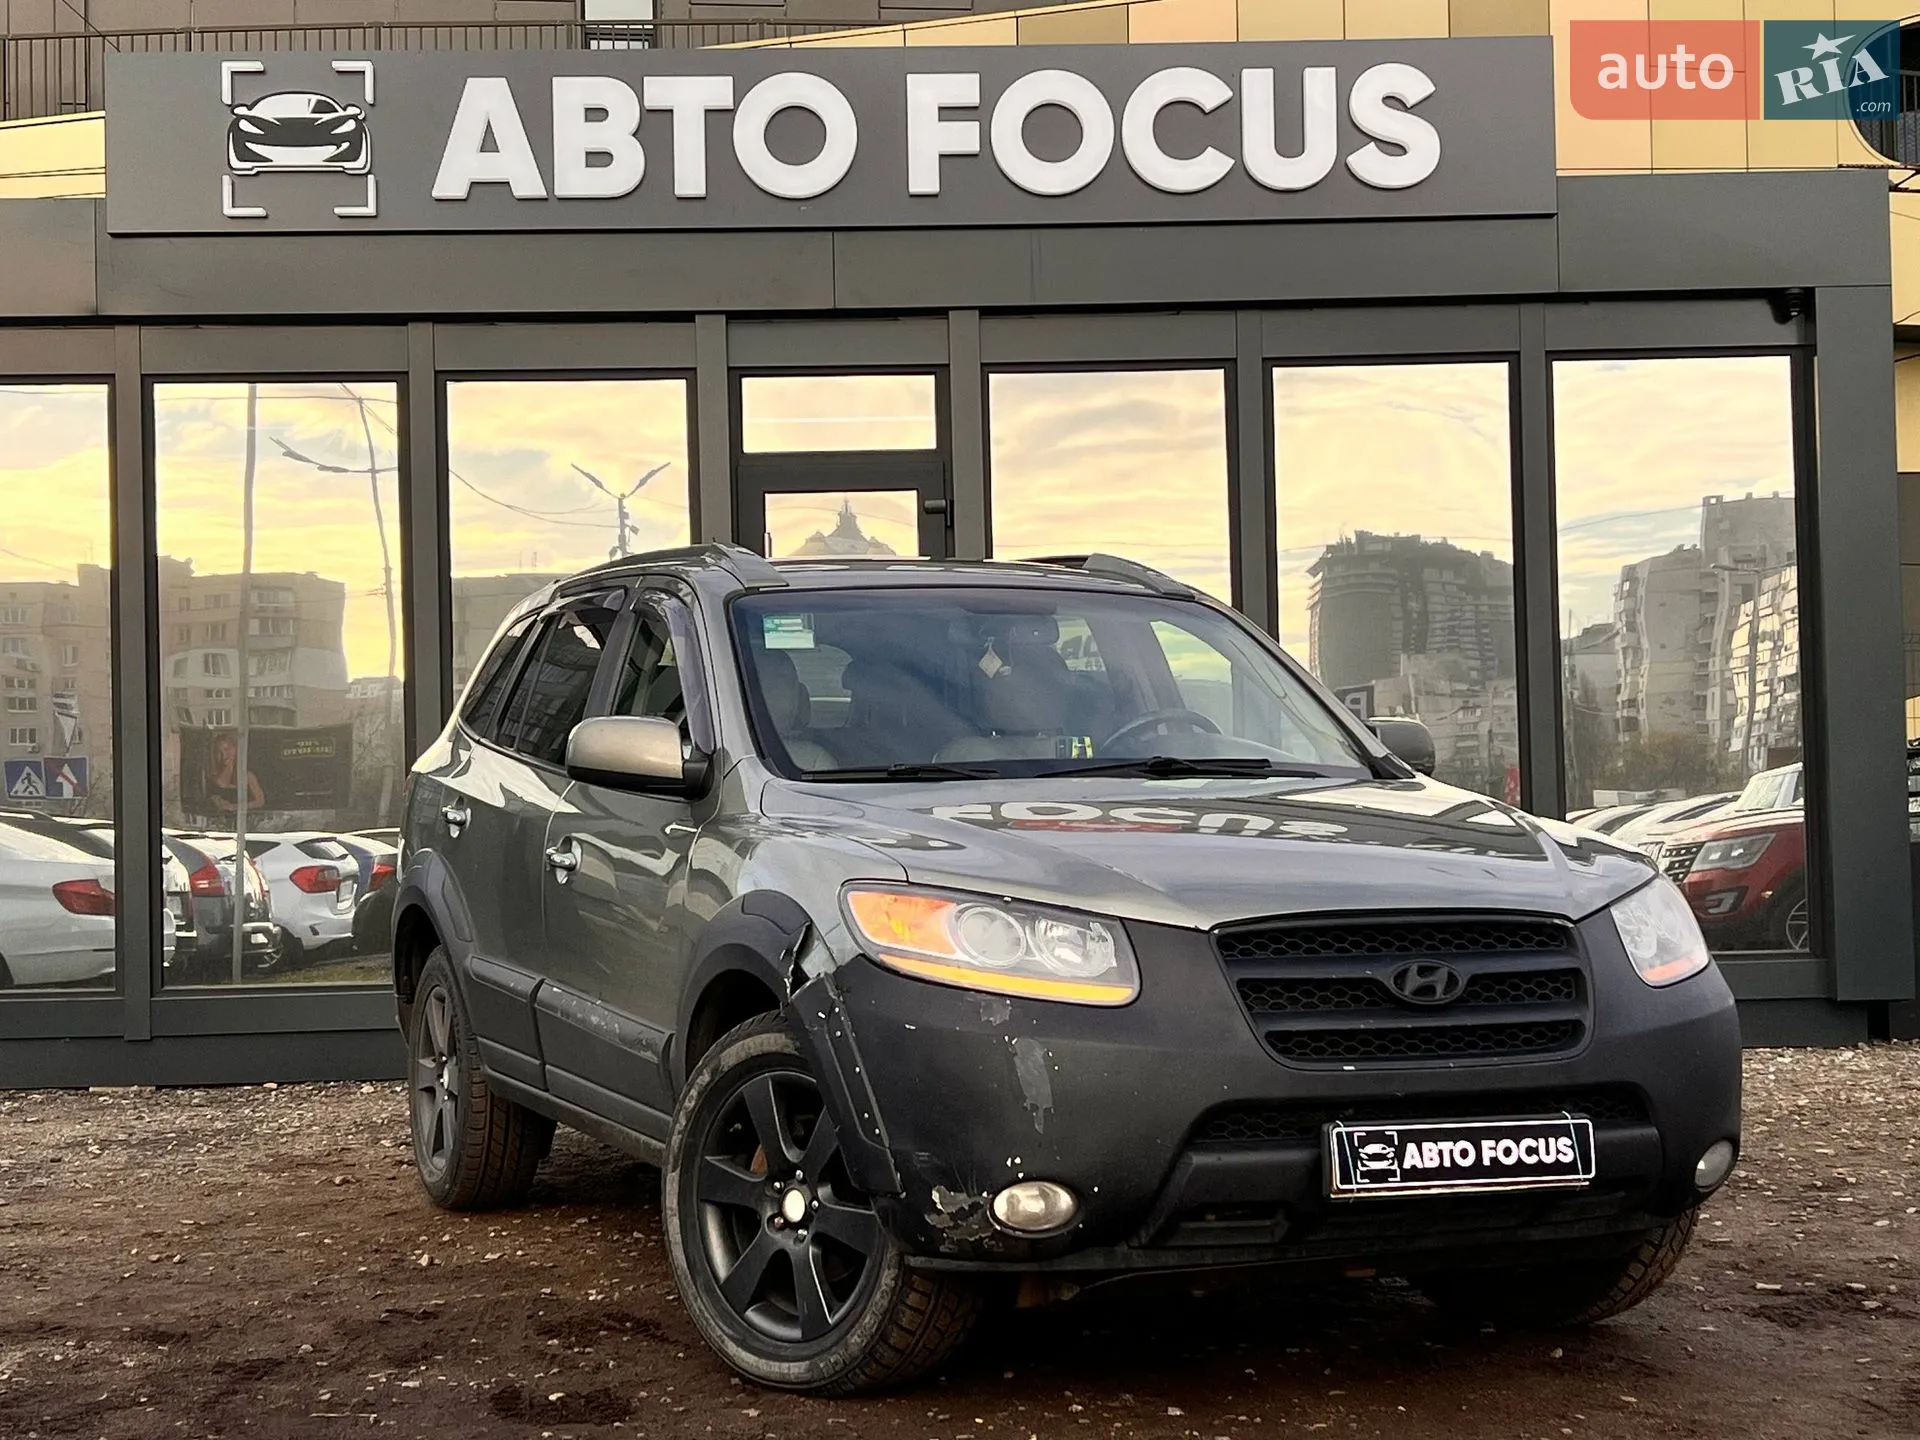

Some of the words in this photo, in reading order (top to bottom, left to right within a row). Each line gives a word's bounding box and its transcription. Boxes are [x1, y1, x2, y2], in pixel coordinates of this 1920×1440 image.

[431, 71, 859, 200] АВТО
[905, 61, 1442, 197] FOCUS
[1402, 1138, 1476, 1170] АВТО
[1481, 1136, 1576, 1167] FOCUS
